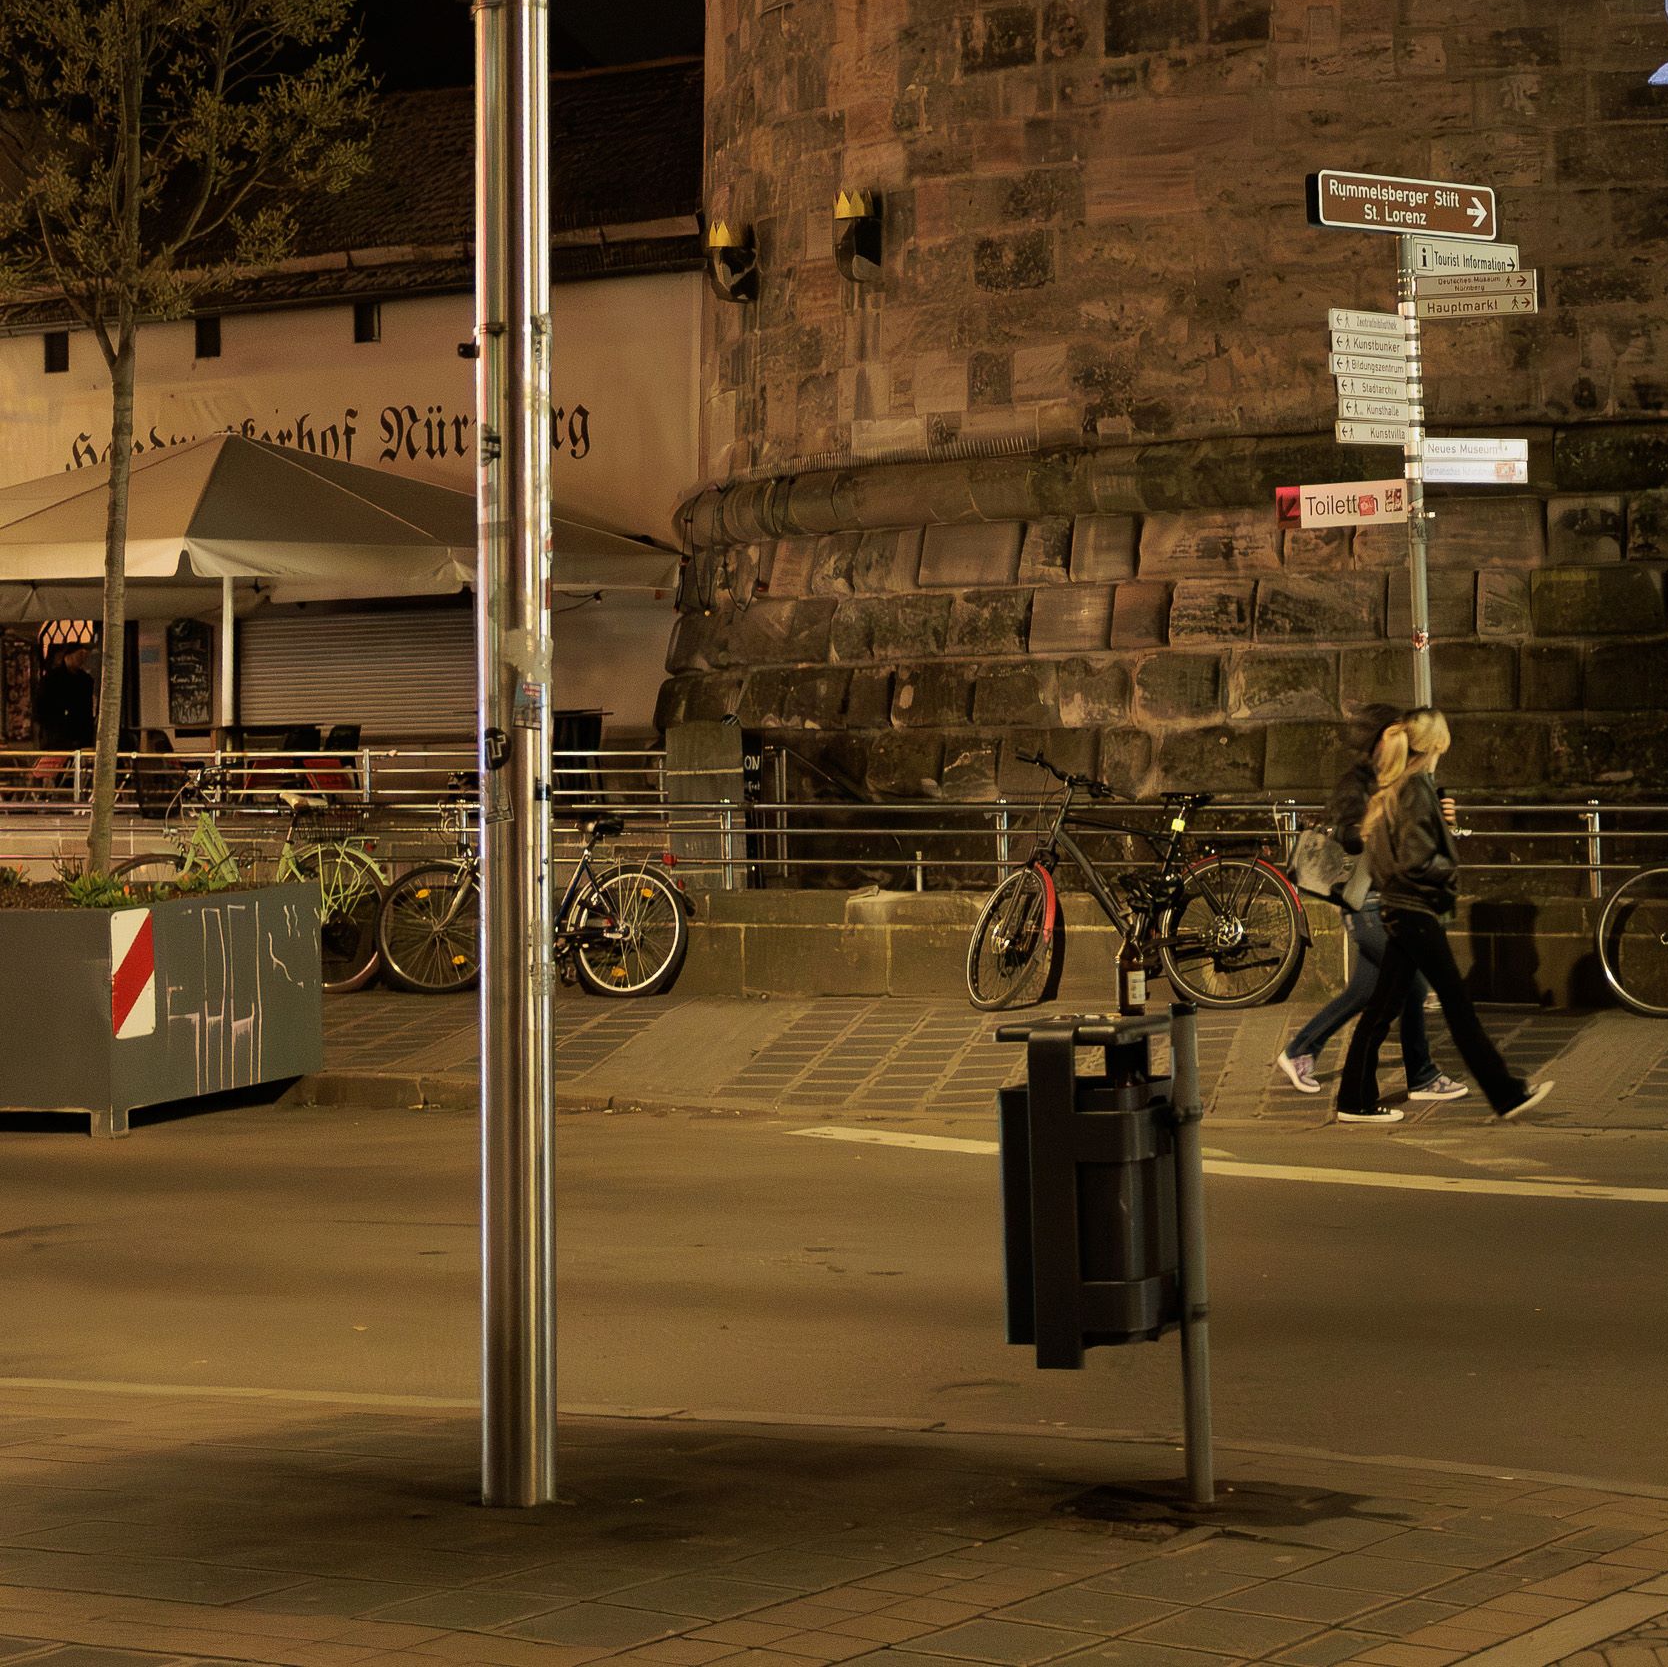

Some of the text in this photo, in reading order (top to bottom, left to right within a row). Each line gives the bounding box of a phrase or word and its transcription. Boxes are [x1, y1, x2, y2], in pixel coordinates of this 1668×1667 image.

[1329, 179, 1460, 208] Rummelsberger Stift
[1364, 204, 1427, 225] St. Lorenz
[1434, 251, 1460, 267] Tourist
[1463, 254, 1506, 272] Information
[1438, 278, 1472, 286] Deutsches
[1427, 299, 1498, 315] Hauptmarkt
[1353, 338, 1401, 353] Kunstbunker
[1351, 359, 1404, 374] Bildungszentrum
[1362, 382, 1398, 395] Stadtarchiv
[1366, 404, 1399, 417] Kunsthalle
[1370, 428, 1405, 440] Kunstvilla
[1427, 443, 1498, 454] Neues Museum
